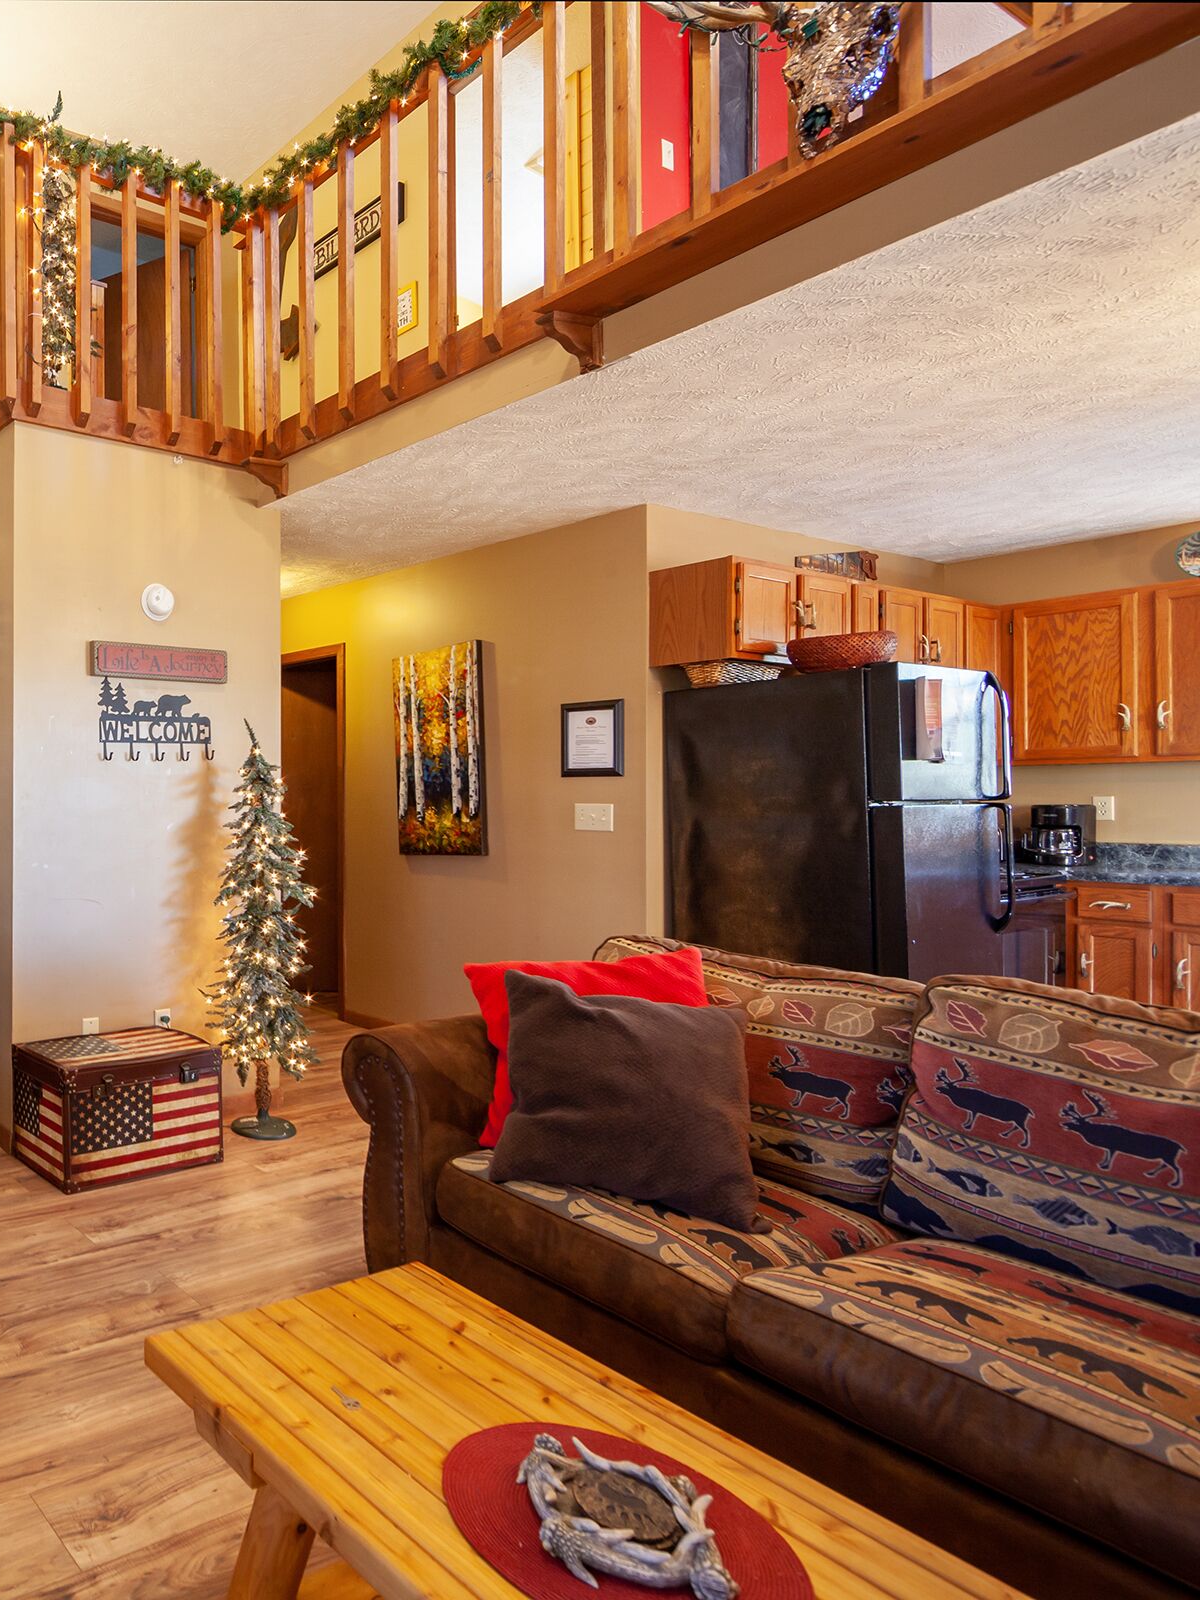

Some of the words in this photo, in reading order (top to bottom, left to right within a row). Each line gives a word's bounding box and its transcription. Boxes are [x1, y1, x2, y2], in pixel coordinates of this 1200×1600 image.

[148, 655, 161, 673] A
[163, 652, 223, 675] Journey
[100, 719, 210, 742] WELCOME
